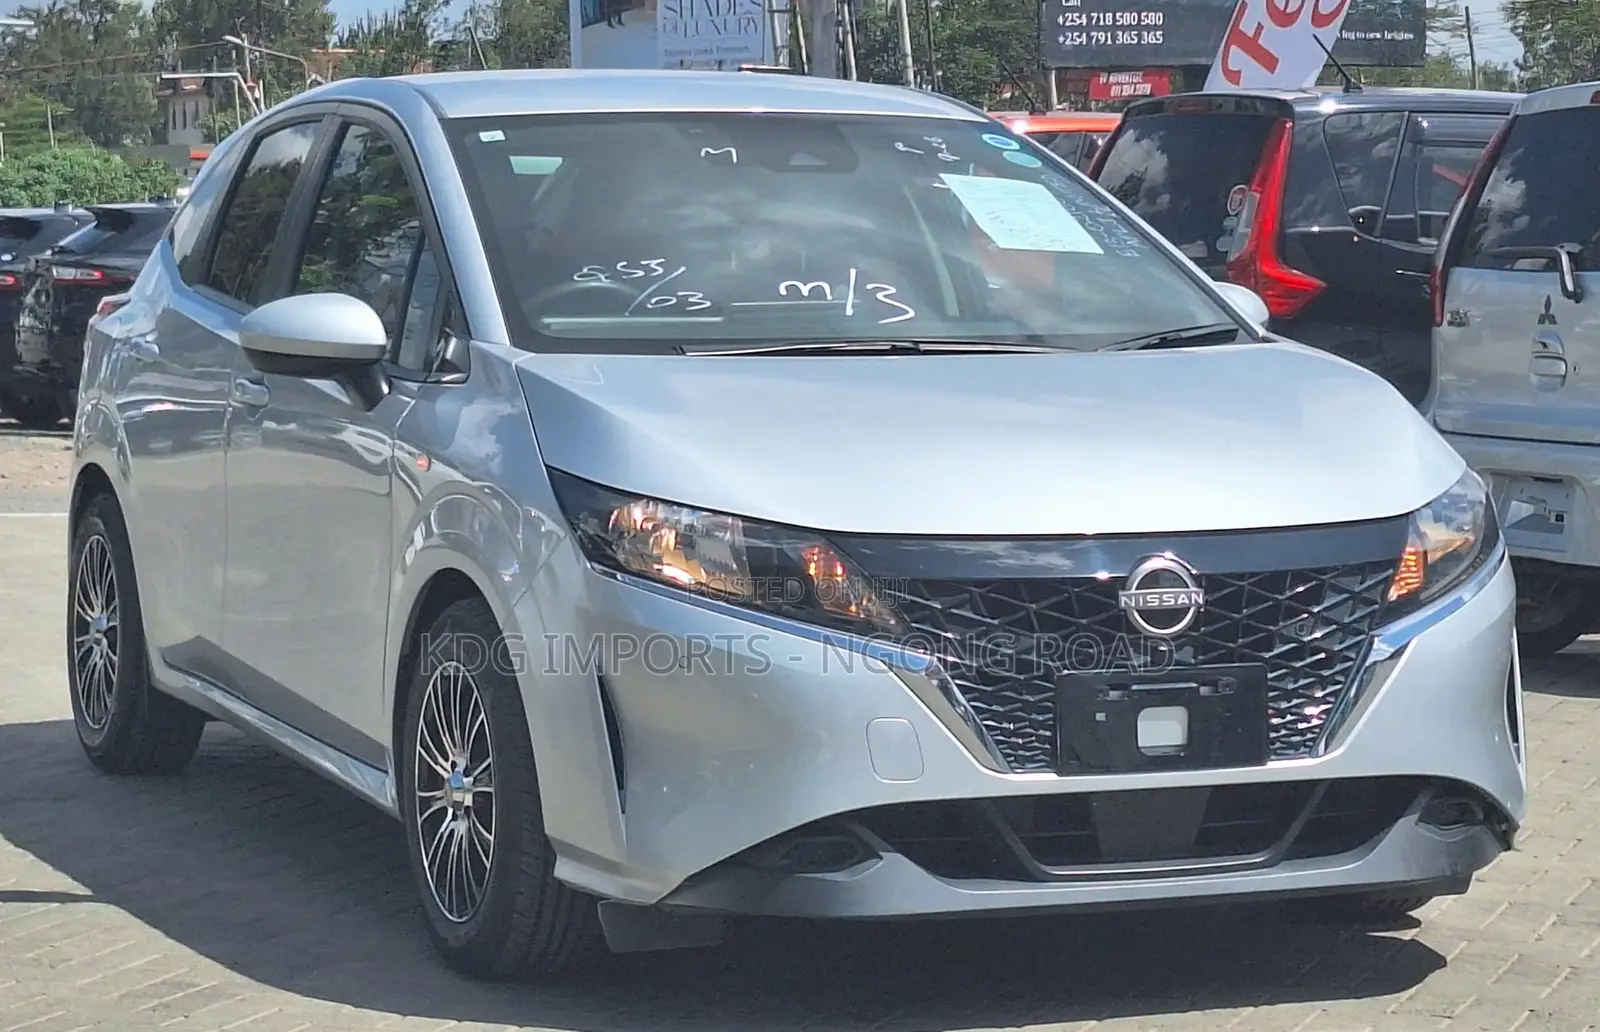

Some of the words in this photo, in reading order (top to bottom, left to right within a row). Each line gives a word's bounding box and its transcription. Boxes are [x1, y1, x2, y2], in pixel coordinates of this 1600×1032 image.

[1057, 12, 1087, 26] +254
[1058, 31, 1087, 45] +254
[1090, 31, 1112, 45] 791
[1115, 30, 1138, 45] 365
[1140, 30, 1163, 45] 365
[1121, 592, 1204, 608] NISSAN
